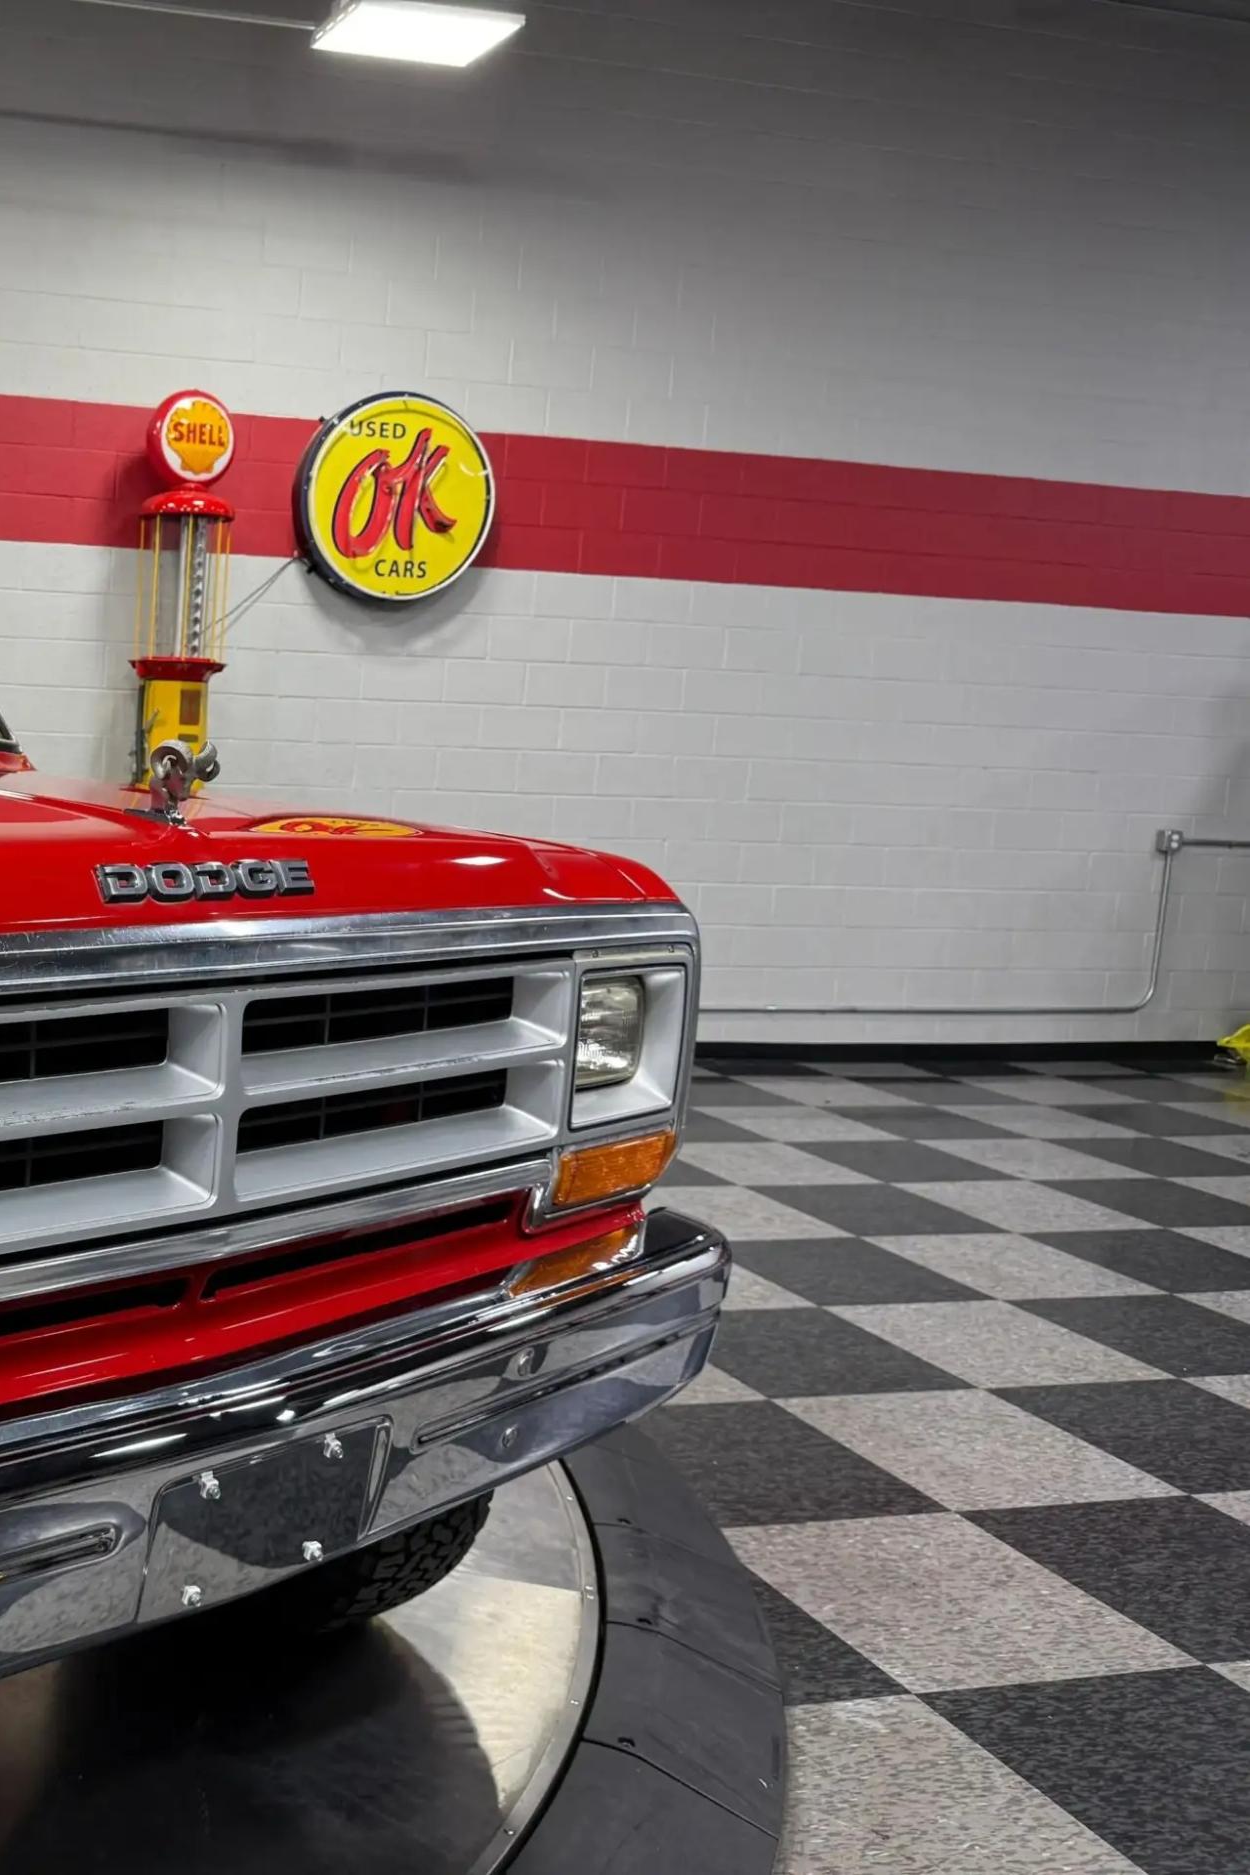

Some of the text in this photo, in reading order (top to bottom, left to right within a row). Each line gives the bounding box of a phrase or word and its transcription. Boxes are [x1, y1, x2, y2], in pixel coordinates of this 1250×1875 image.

[171, 422, 225, 447] SHELL
[350, 420, 407, 440] USED
[331, 427, 457, 559] OK
[374, 559, 427, 579] CARS
[96, 858, 315, 904] DODGE
